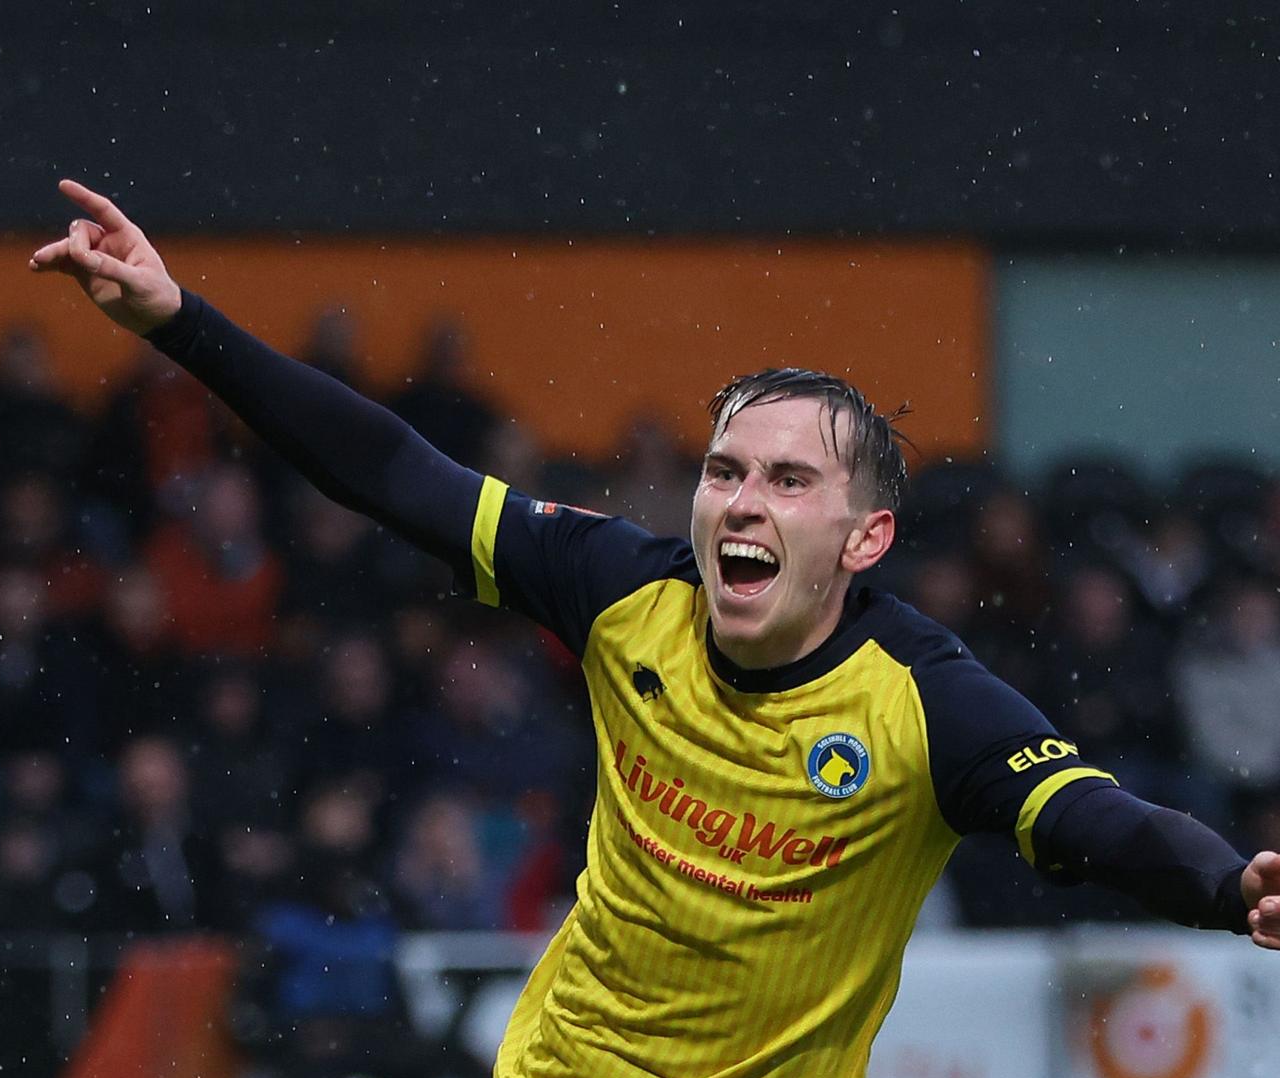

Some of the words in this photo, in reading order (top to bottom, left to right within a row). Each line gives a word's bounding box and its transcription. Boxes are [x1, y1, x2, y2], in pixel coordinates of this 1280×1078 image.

[848, 738, 866, 757] MOORS
[811, 775, 841, 796] FOOTBALL
[841, 783, 858, 796] CLUB
[718, 844, 748, 865] UK
[676, 858, 745, 897] mental
[746, 883, 813, 904] health
